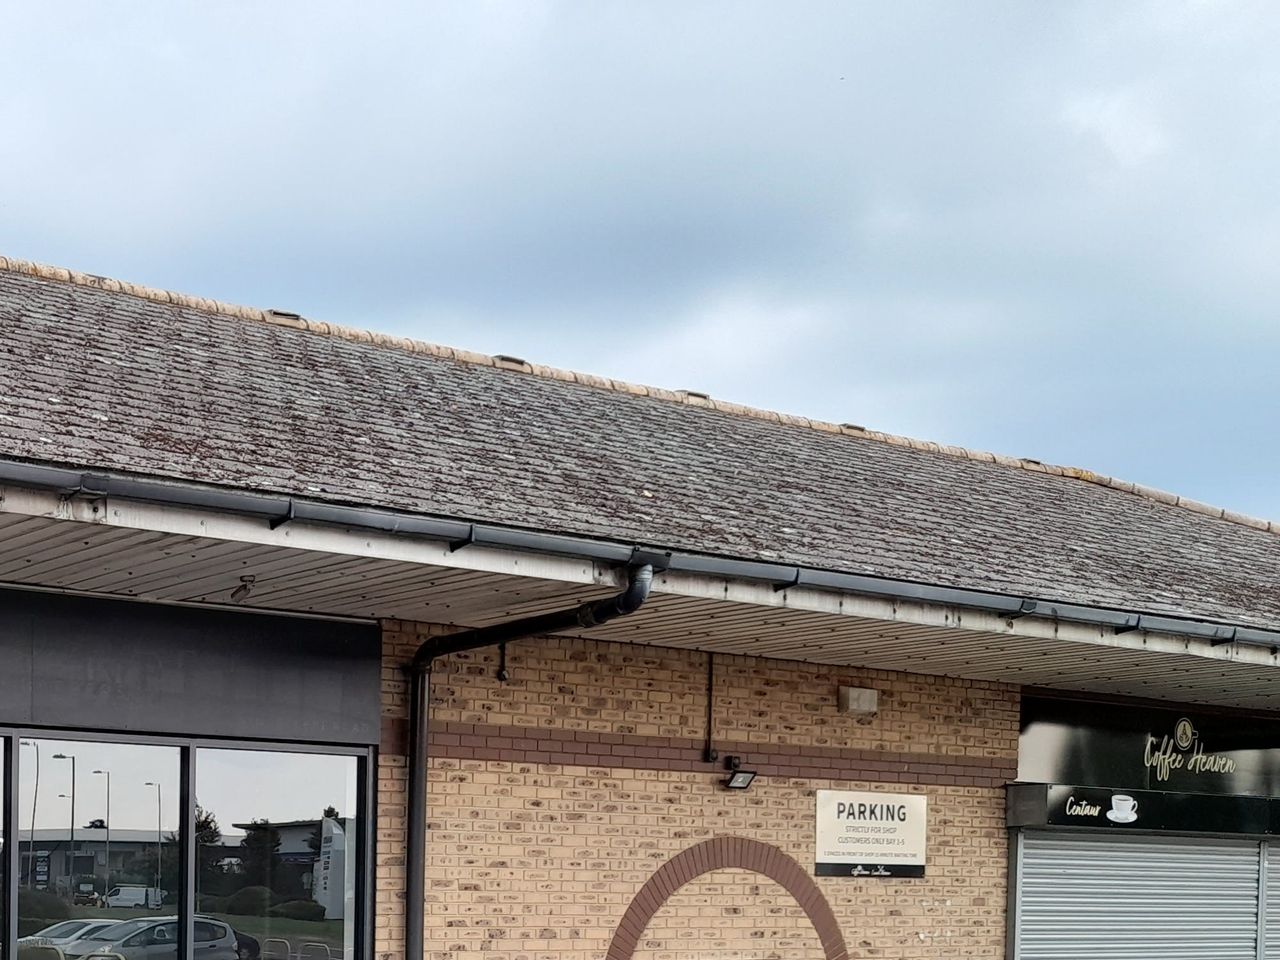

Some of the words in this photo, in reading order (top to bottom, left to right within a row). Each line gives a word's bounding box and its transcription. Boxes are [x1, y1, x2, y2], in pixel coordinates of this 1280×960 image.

[1144, 735, 1184, 781] Coffee
[1188, 740, 1236, 774] Heaven
[837, 802, 907, 822] PARKING
[845, 826, 870, 834] STRICTLY
[870, 826, 882, 834] FOR
[882, 826, 897, 835] SHOP
[837, 836, 871, 845] CUSTOMERS
[871, 837, 885, 845] ONLY
[885, 837, 896, 845] BAY
